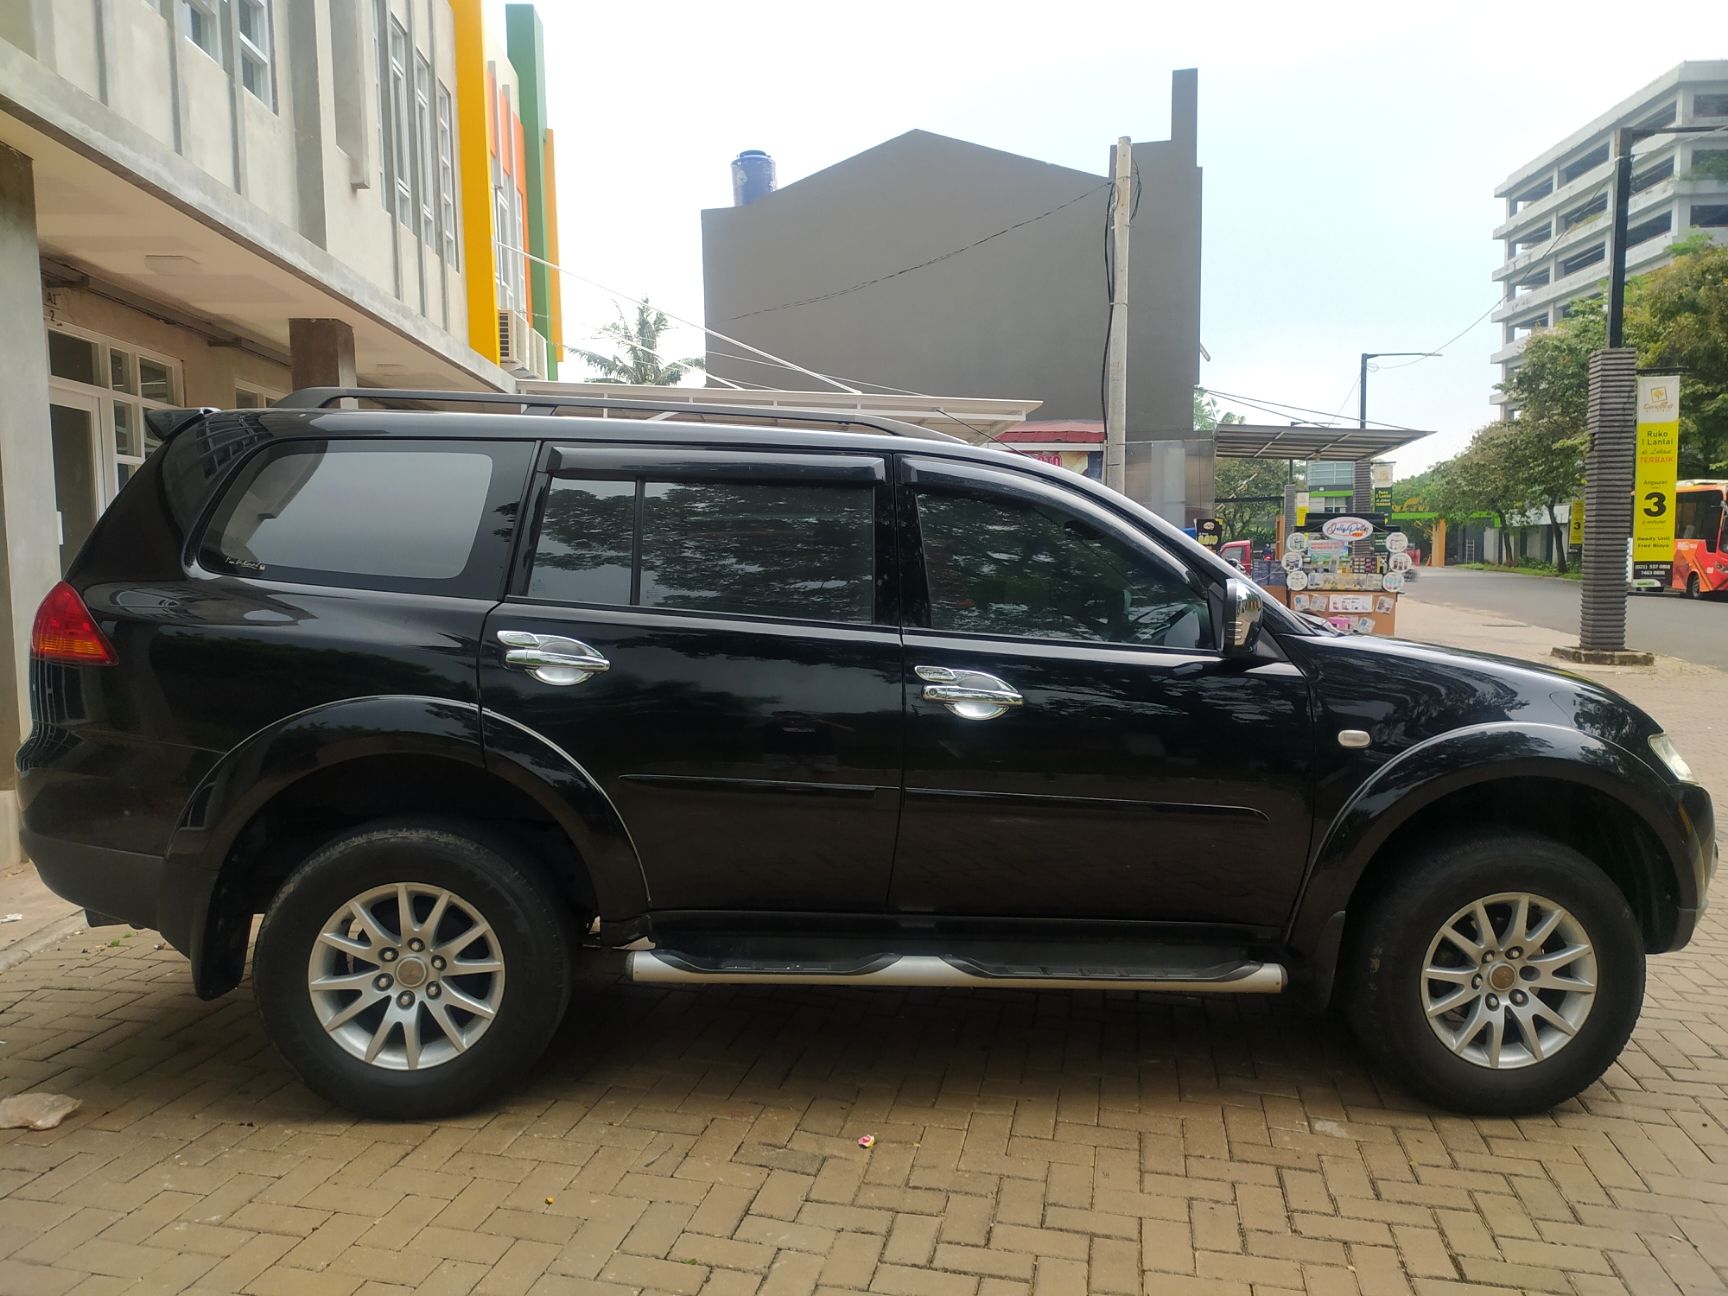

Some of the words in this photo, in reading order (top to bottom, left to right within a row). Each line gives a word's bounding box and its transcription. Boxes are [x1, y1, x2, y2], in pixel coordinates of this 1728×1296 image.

[1647, 430, 1668, 438] Ruko
[1647, 438, 1673, 446] Lantai
[1640, 456, 1674, 464] TERBAIK
[1643, 491, 1667, 517] 3
[1574, 522, 1581, 530] 3
